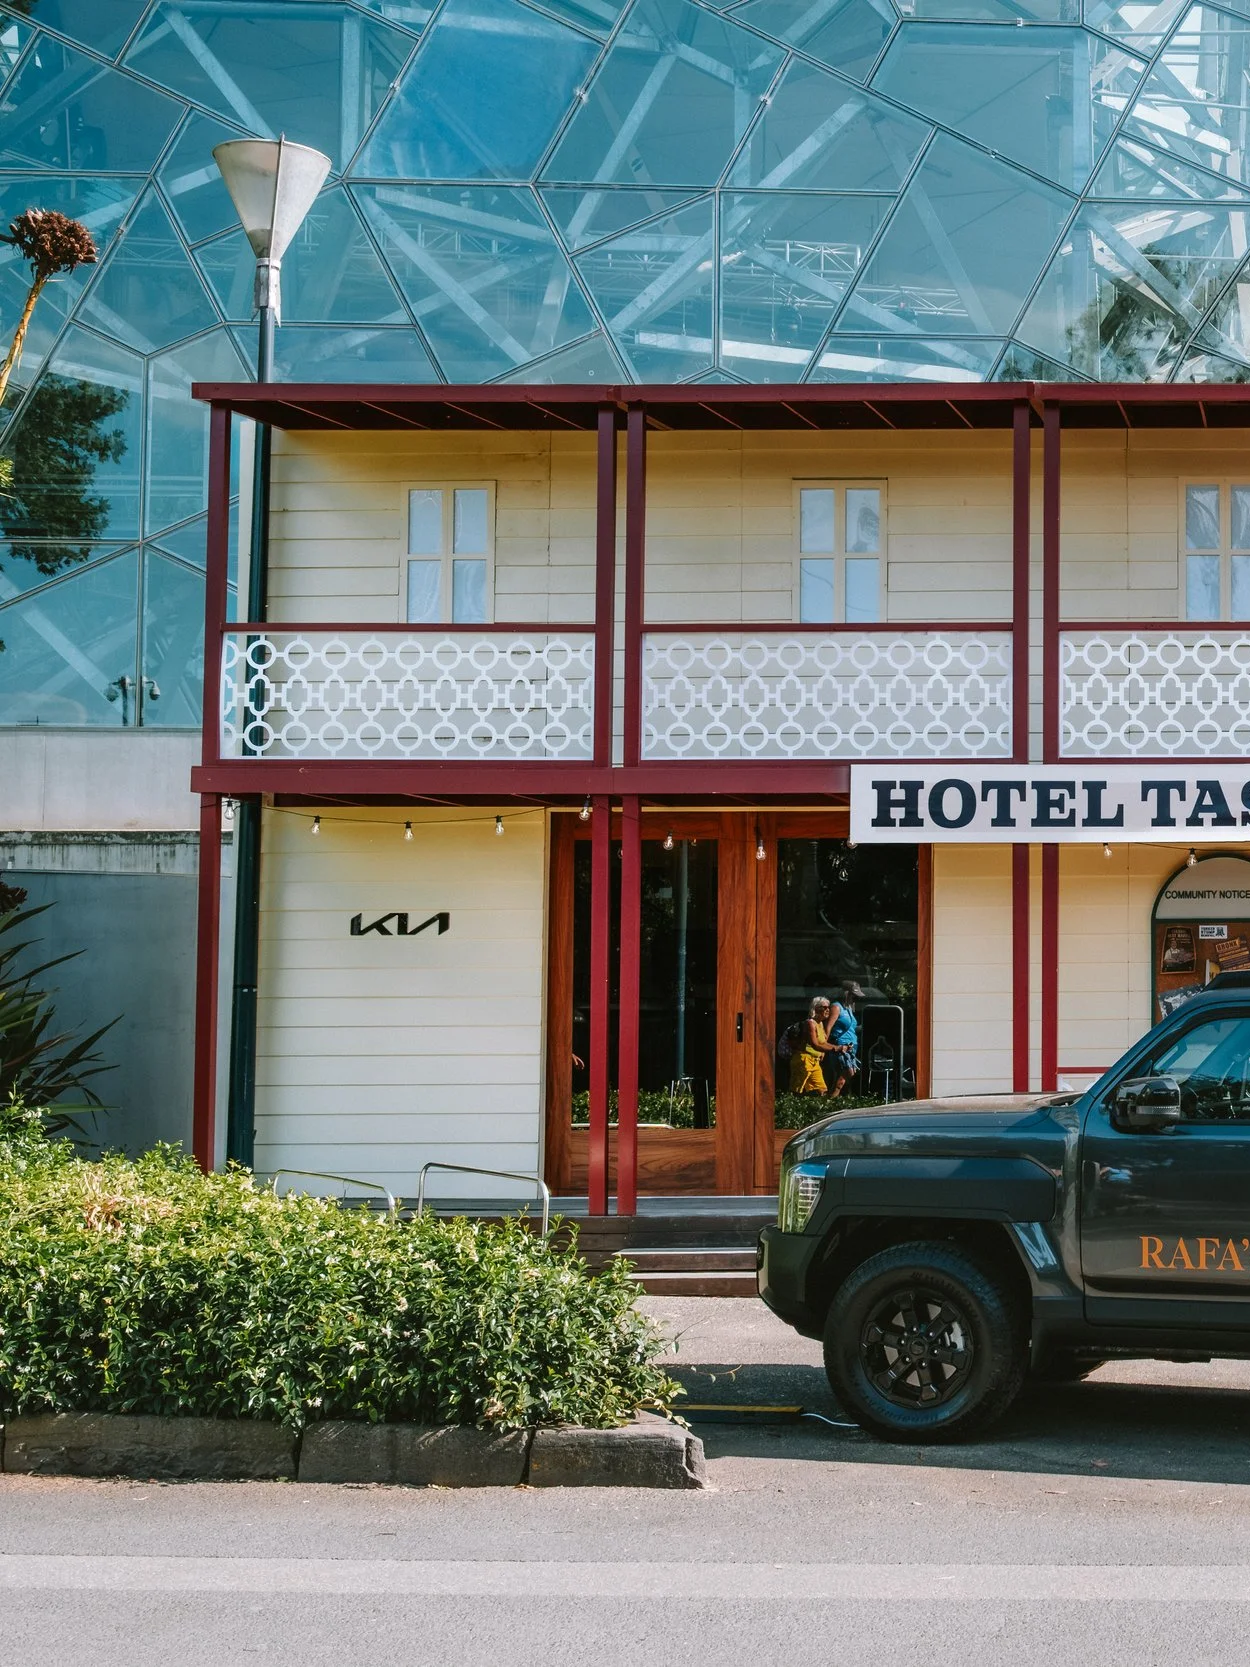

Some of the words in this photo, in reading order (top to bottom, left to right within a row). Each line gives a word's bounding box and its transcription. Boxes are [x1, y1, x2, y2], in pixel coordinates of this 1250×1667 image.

[871, 779, 1125, 828] HOTEL
[1164, 890, 1217, 899] COMMUNITY
[1219, 890, 1250, 899] NOTICE
[350, 912, 451, 936] KIA
